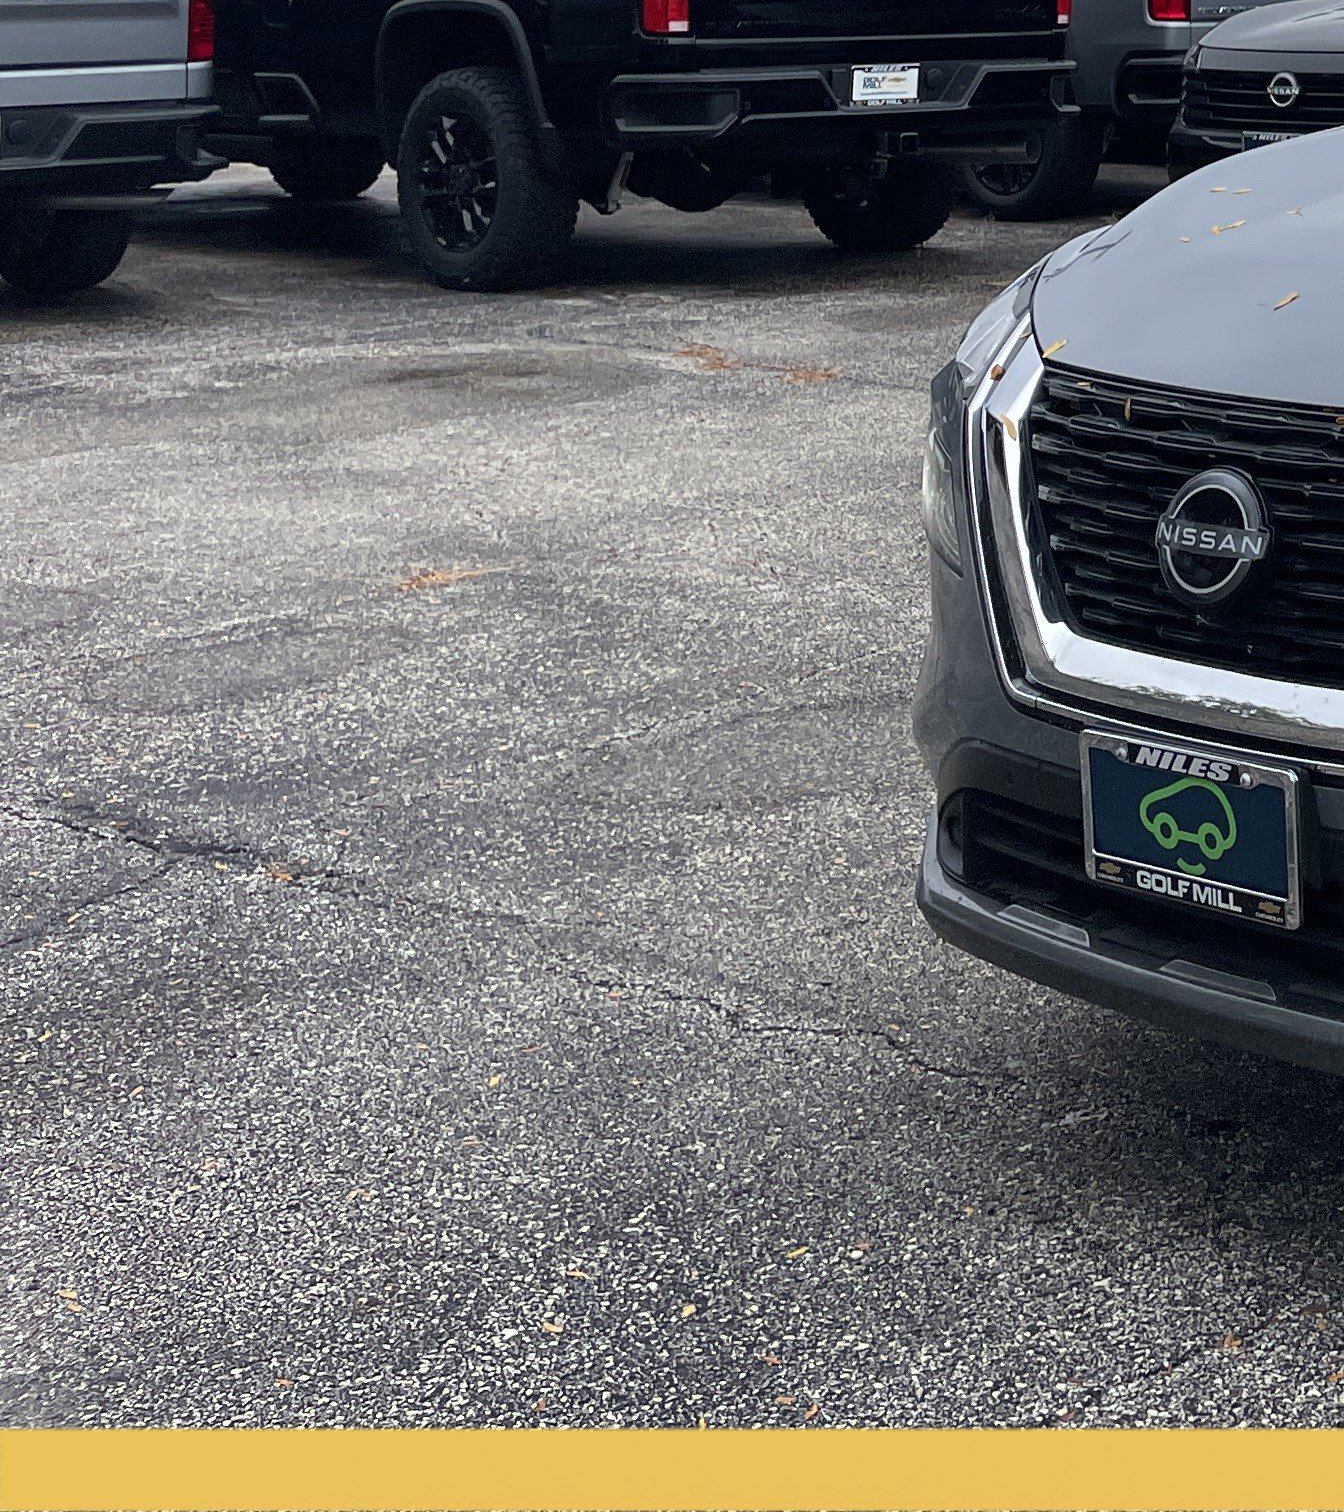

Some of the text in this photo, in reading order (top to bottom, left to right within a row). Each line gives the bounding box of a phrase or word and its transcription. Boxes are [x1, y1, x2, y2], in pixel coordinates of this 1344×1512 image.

[1158, 521, 1263, 555] NISSAN
[1135, 746, 1232, 782] NILES
[1136, 870, 1242, 913] GOLF MILL
